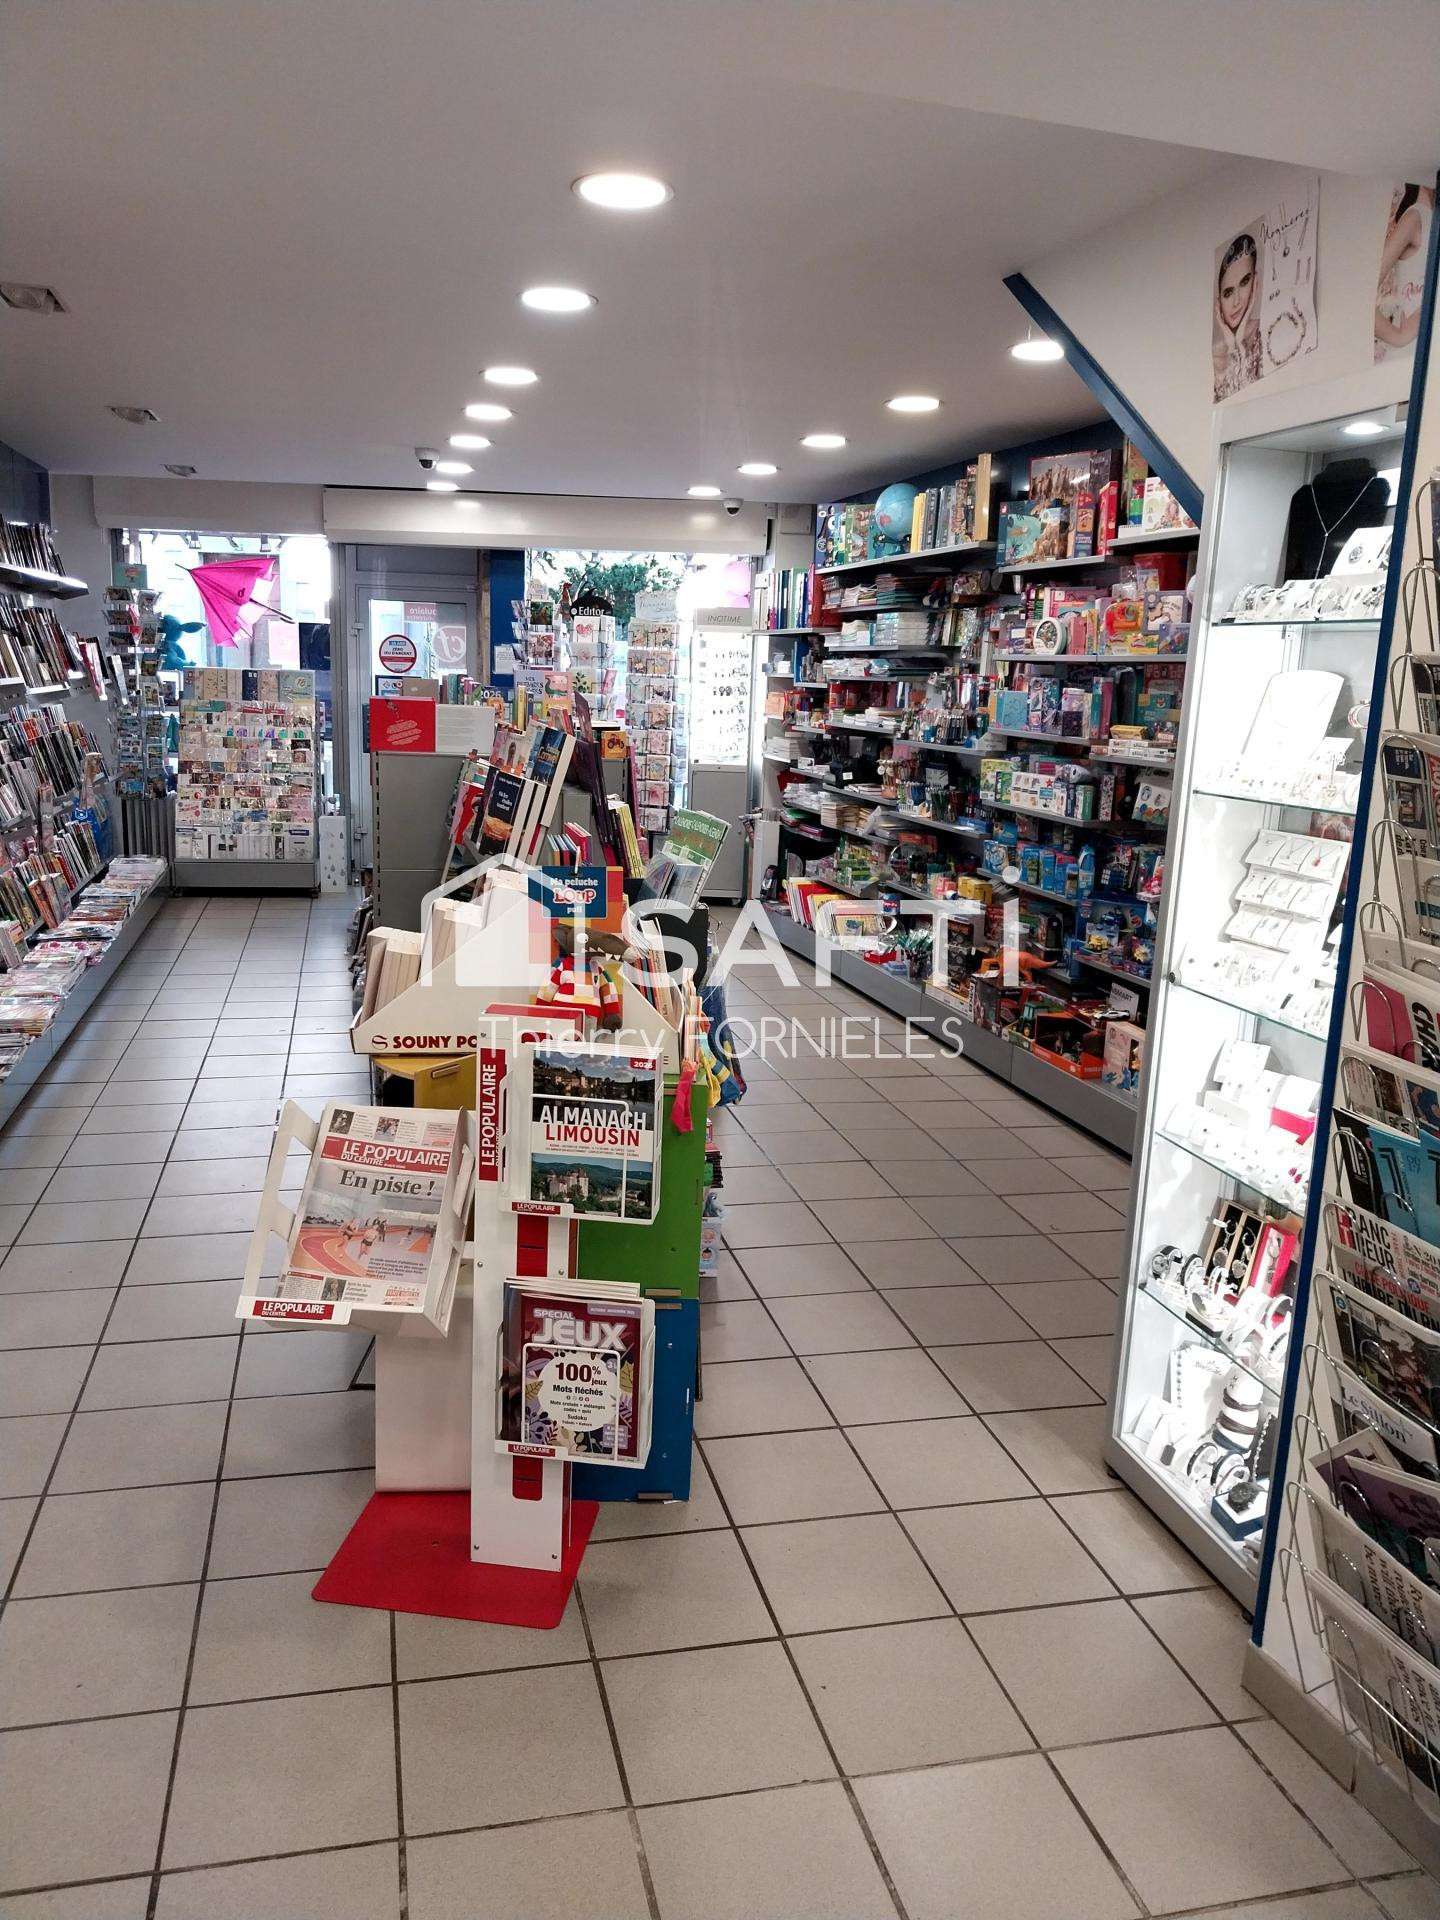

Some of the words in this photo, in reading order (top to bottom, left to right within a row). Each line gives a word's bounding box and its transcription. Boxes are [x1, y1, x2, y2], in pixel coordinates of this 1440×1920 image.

[578, 606, 605, 616] Editor
[565, 877, 599, 888] peluche
[553, 888, 596, 904] LOUP
[392, 1035, 451, 1049] SOUNY
[456, 1035, 478, 1049] PO
[481, 1064, 497, 1148] POPULAIRE
[540, 1105, 648, 1131] ALMANACH
[546, 1124, 641, 1147] LIMOUSIN
[341, 1152, 353, 1161] DU
[354, 1156, 385, 1166] CENTRE
[342, 1140, 361, 1156] LE
[363, 1144, 450, 1167] POPULAIRE
[482, 1149, 496, 1166] LE
[339, 1168, 368, 1189] En
[371, 1176, 422, 1196] piste
[262, 1301, 275, 1312] LE
[274, 1302, 326, 1314] POPULAIRE
[532, 1318, 628, 1352] JEUX
[556, 1362, 592, 1383] 100
[552, 1384, 573, 1394] Mots
[574, 1385, 604, 1397] fléchés
[591, 1379, 608, 1387] jeux
[567, 1413, 588, 1421] Sudoku
